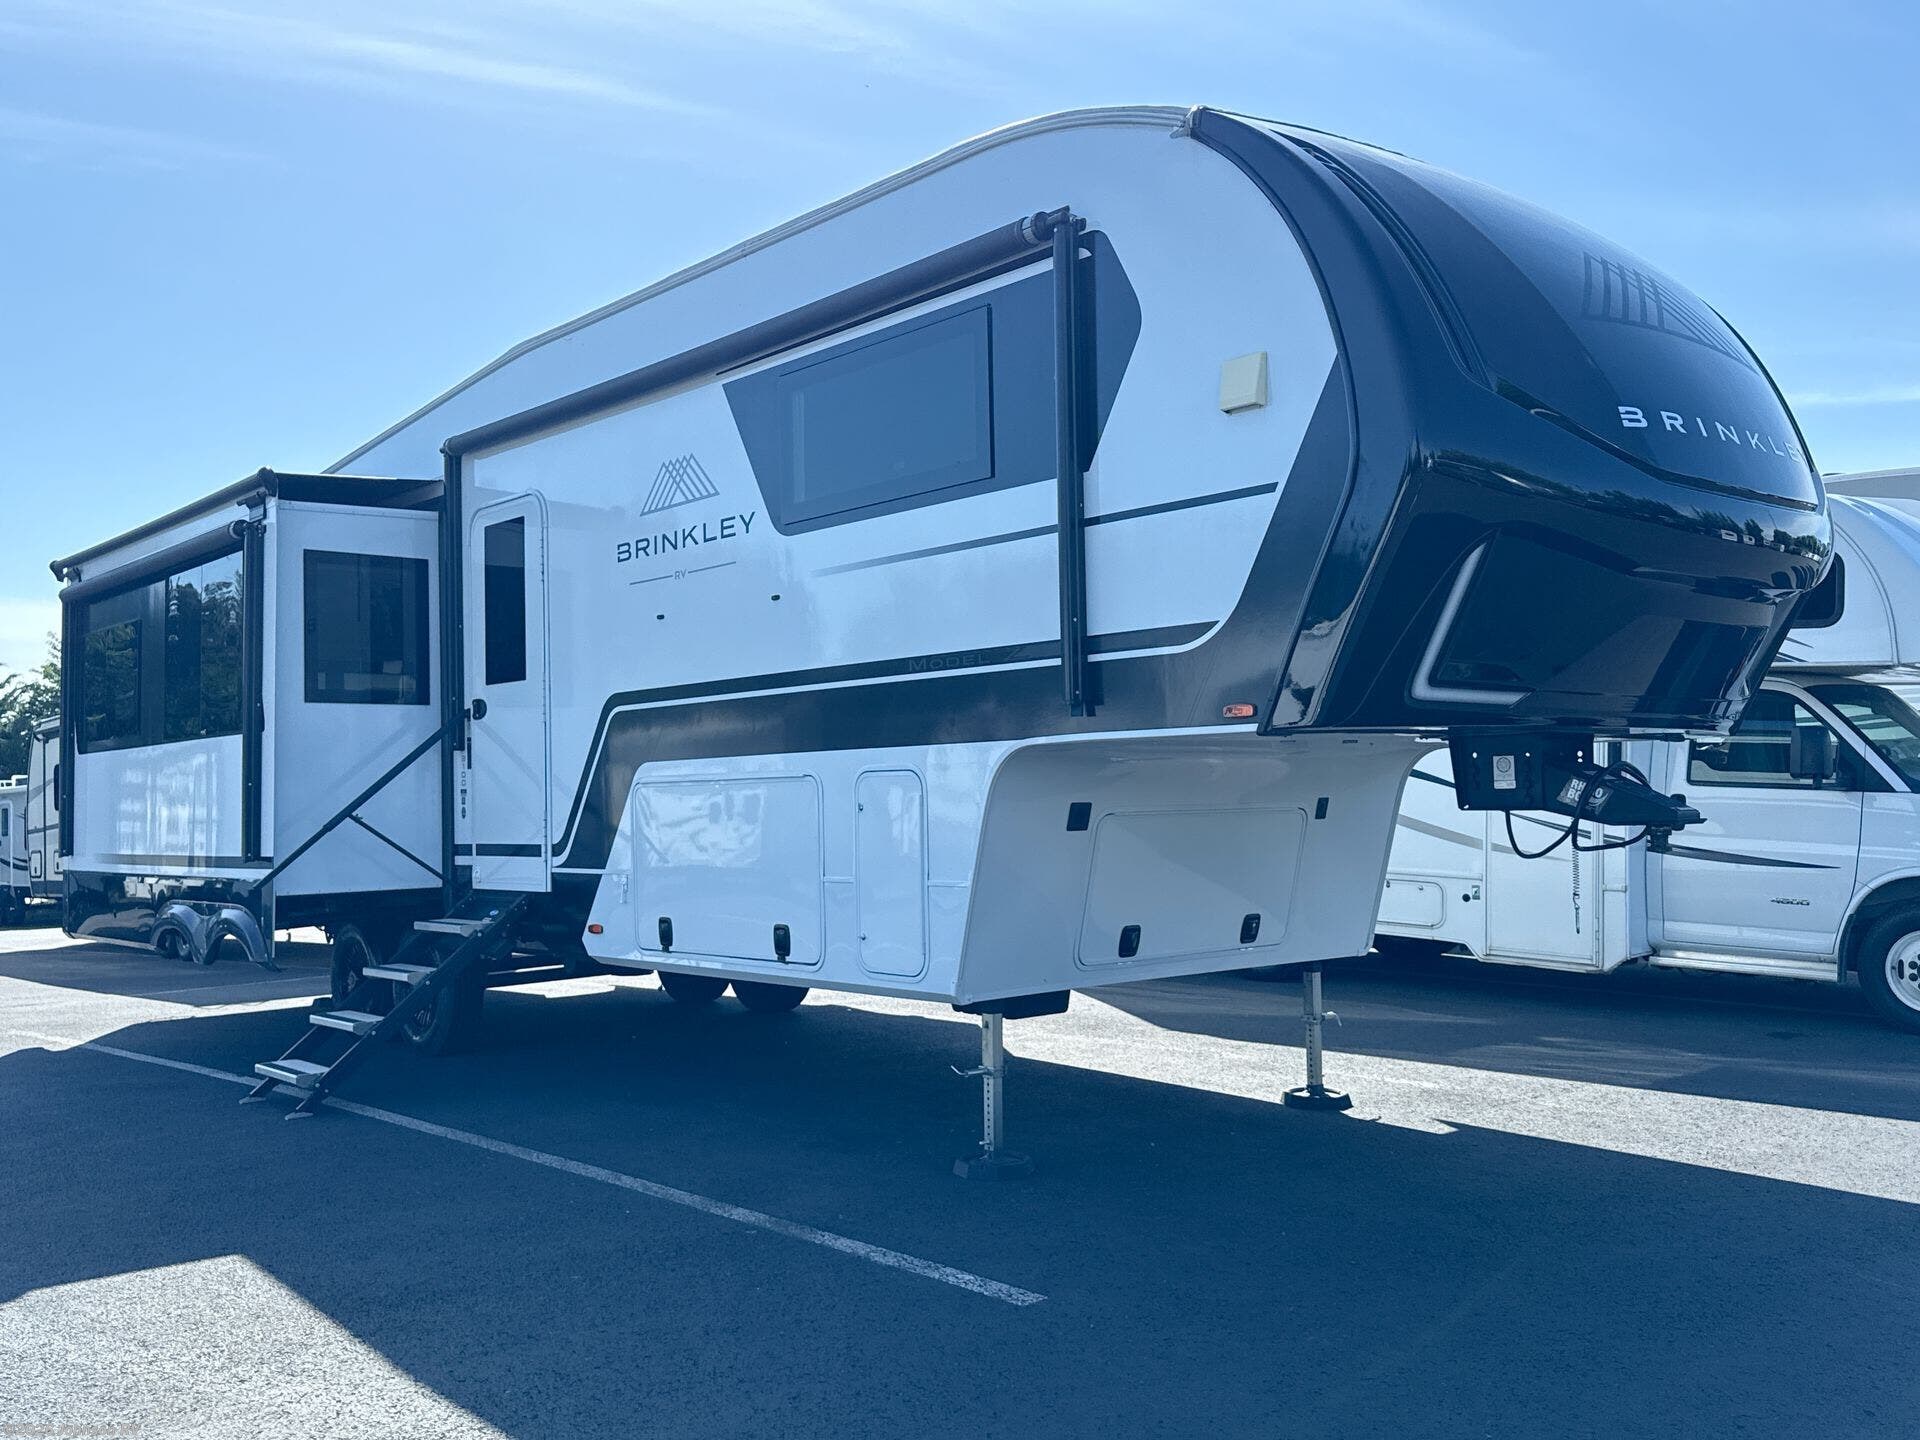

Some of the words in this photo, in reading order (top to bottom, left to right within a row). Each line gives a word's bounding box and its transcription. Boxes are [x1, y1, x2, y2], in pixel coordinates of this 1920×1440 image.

[617, 511, 756, 563] BRINKLEY
[674, 569, 687, 581] RV
[908, 653, 990, 672] MODEL
[1570, 778, 1604, 799] RHO
